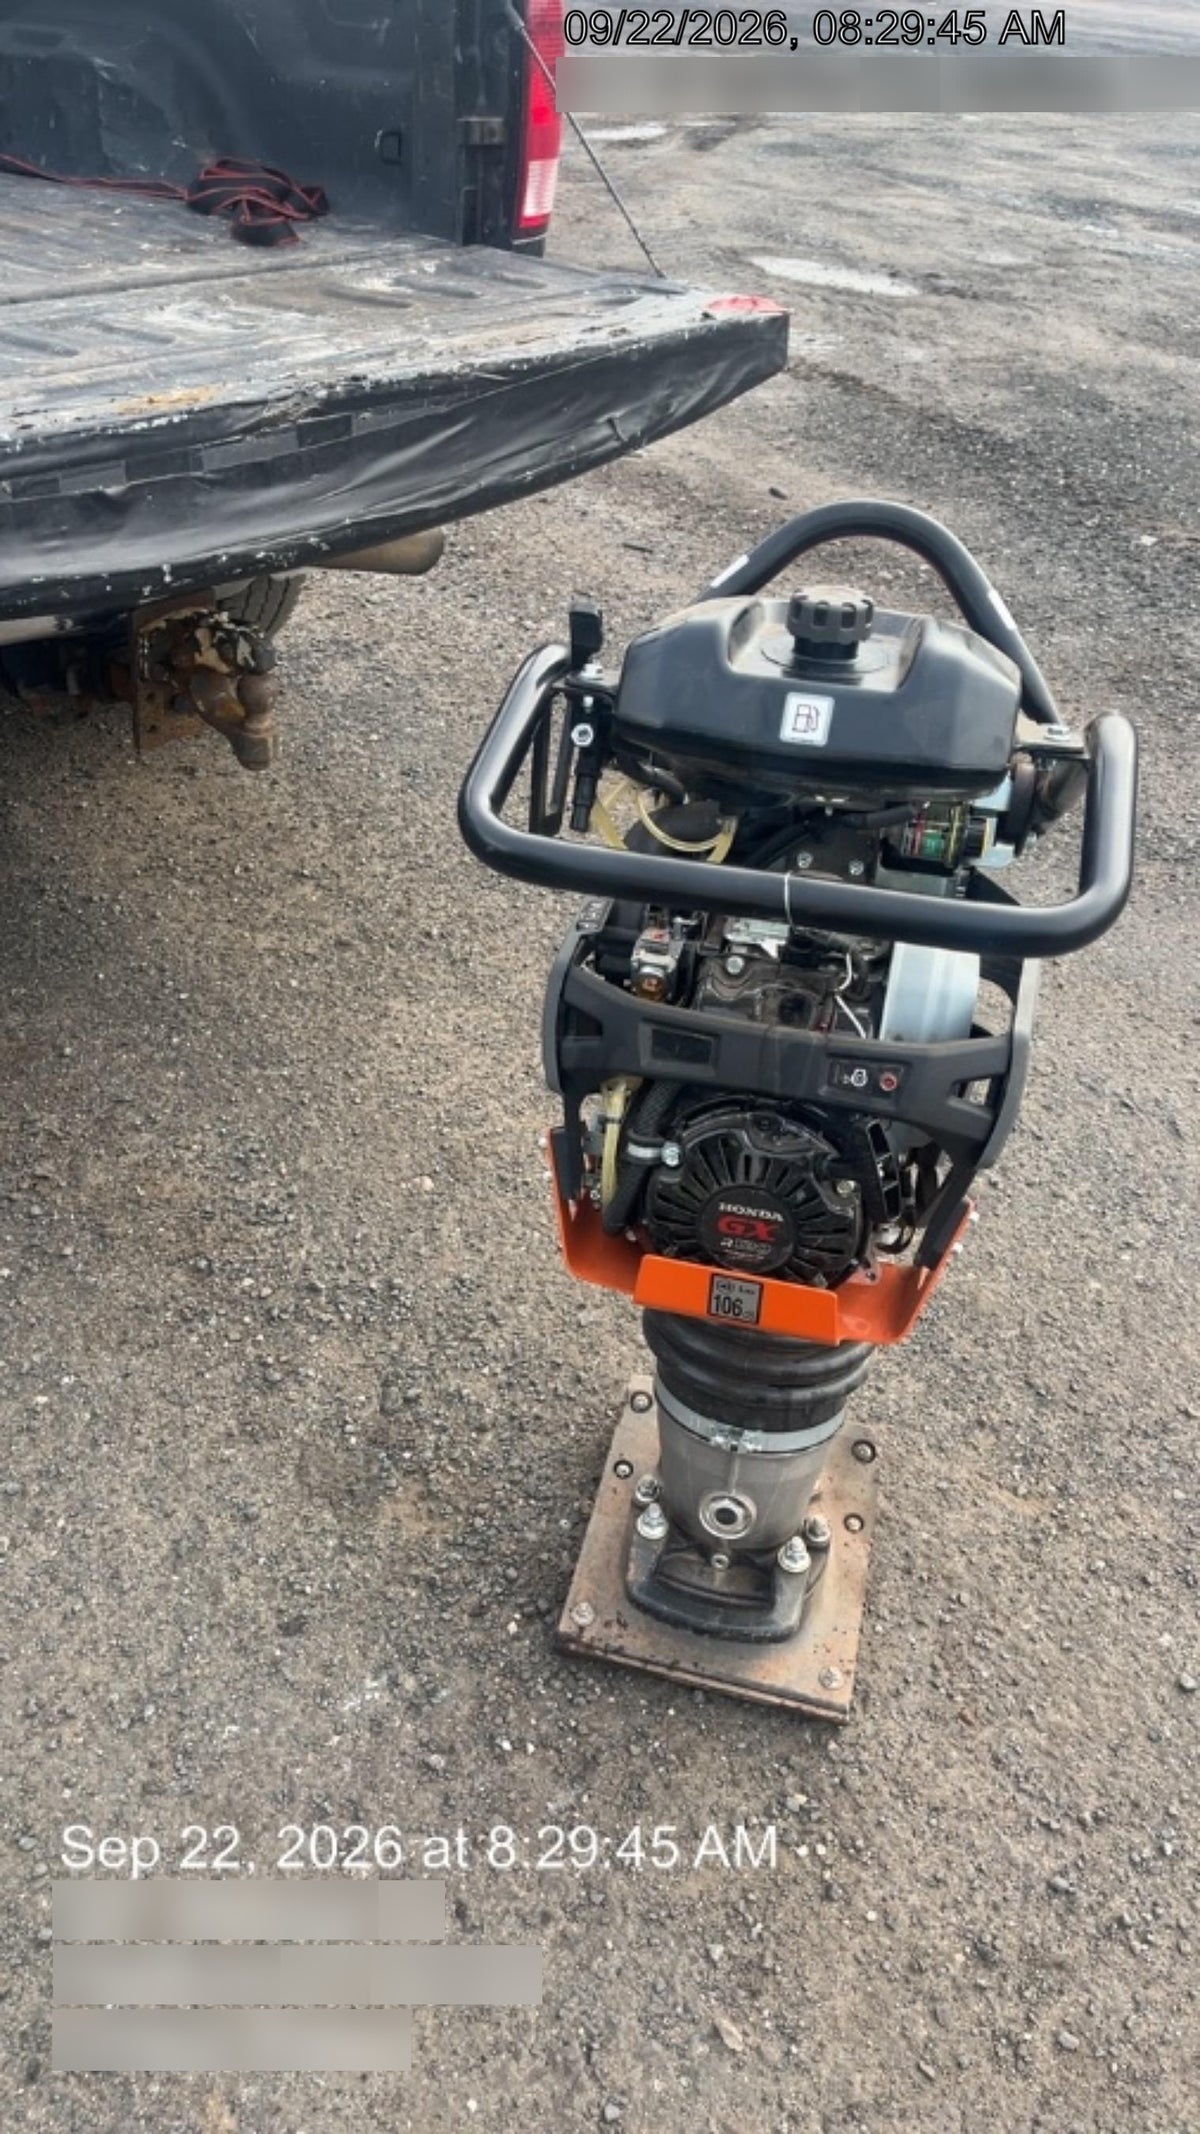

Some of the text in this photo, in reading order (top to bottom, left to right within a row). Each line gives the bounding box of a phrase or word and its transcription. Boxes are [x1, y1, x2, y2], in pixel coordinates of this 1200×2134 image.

[718, 1201, 784, 1222] HONDA
[718, 1214, 780, 1241] GX
[713, 1294, 743, 1316] 106
